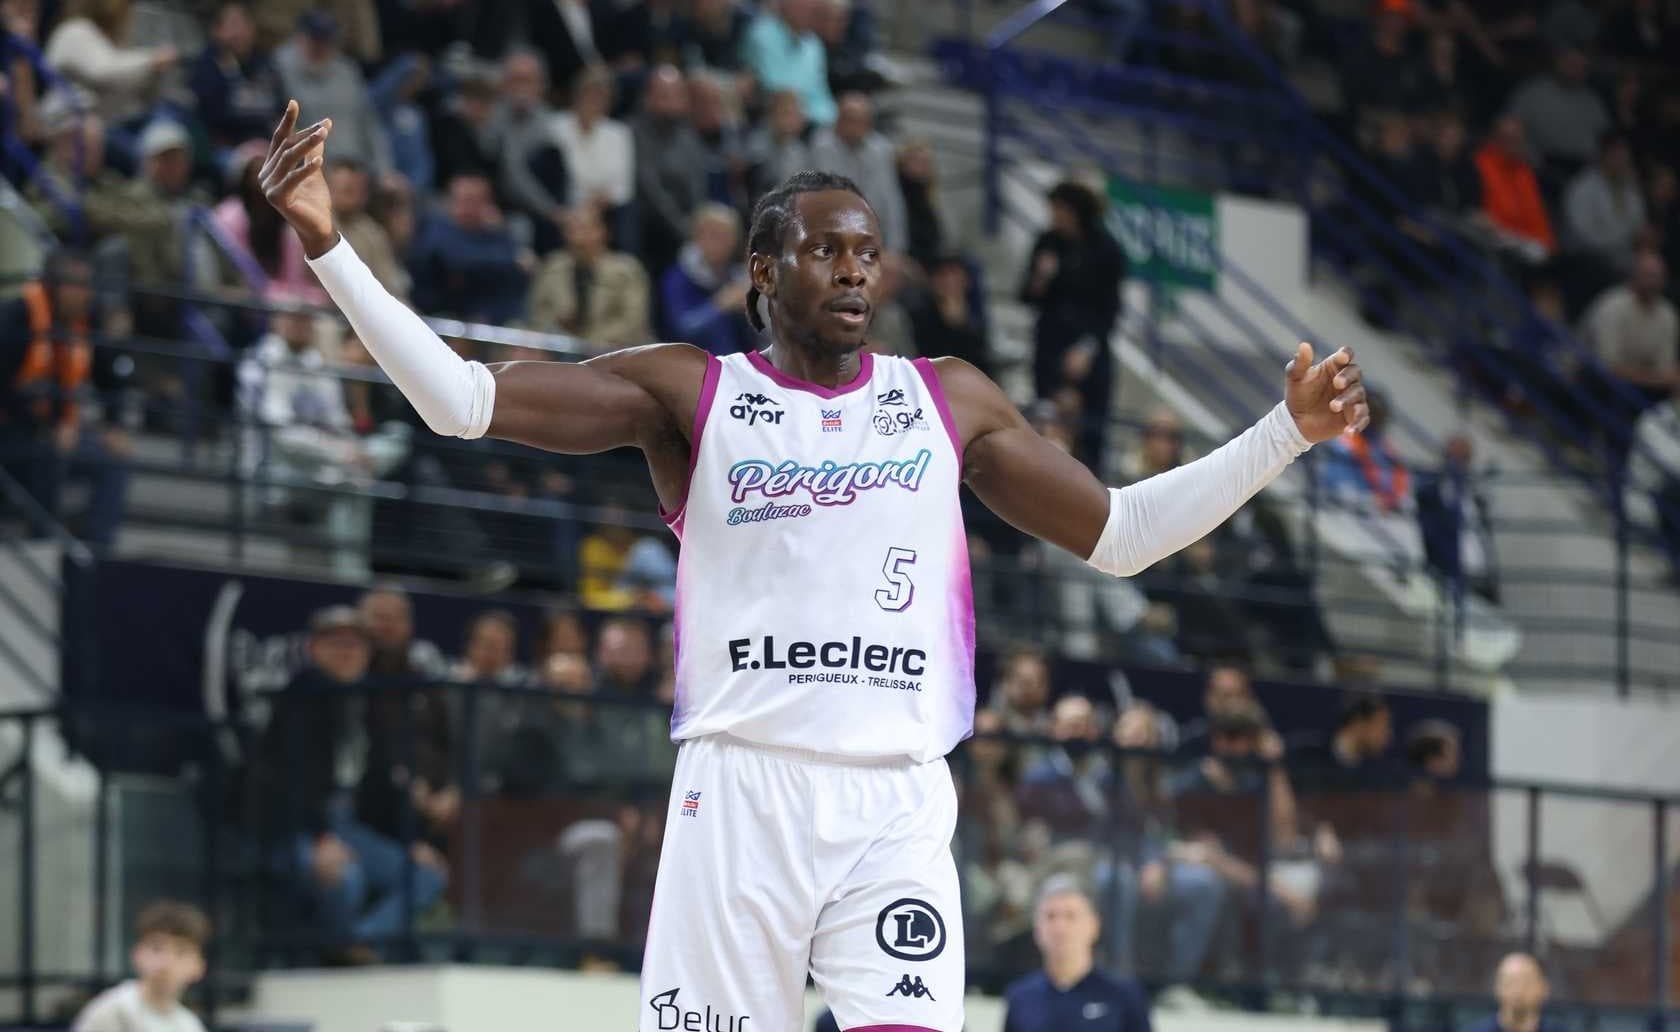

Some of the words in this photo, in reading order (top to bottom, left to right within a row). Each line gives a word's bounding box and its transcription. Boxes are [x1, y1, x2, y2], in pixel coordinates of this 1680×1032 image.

[730, 404, 785, 426] ayor
[728, 448, 932, 507] Périgord
[727, 501, 812, 526] Boulazac
[874, 546, 917, 613] 5
[728, 635, 926, 677] E.Leclerc
[788, 672, 859, 685] PERIGUEUX
[868, 676, 923, 692] TRELISSAC
